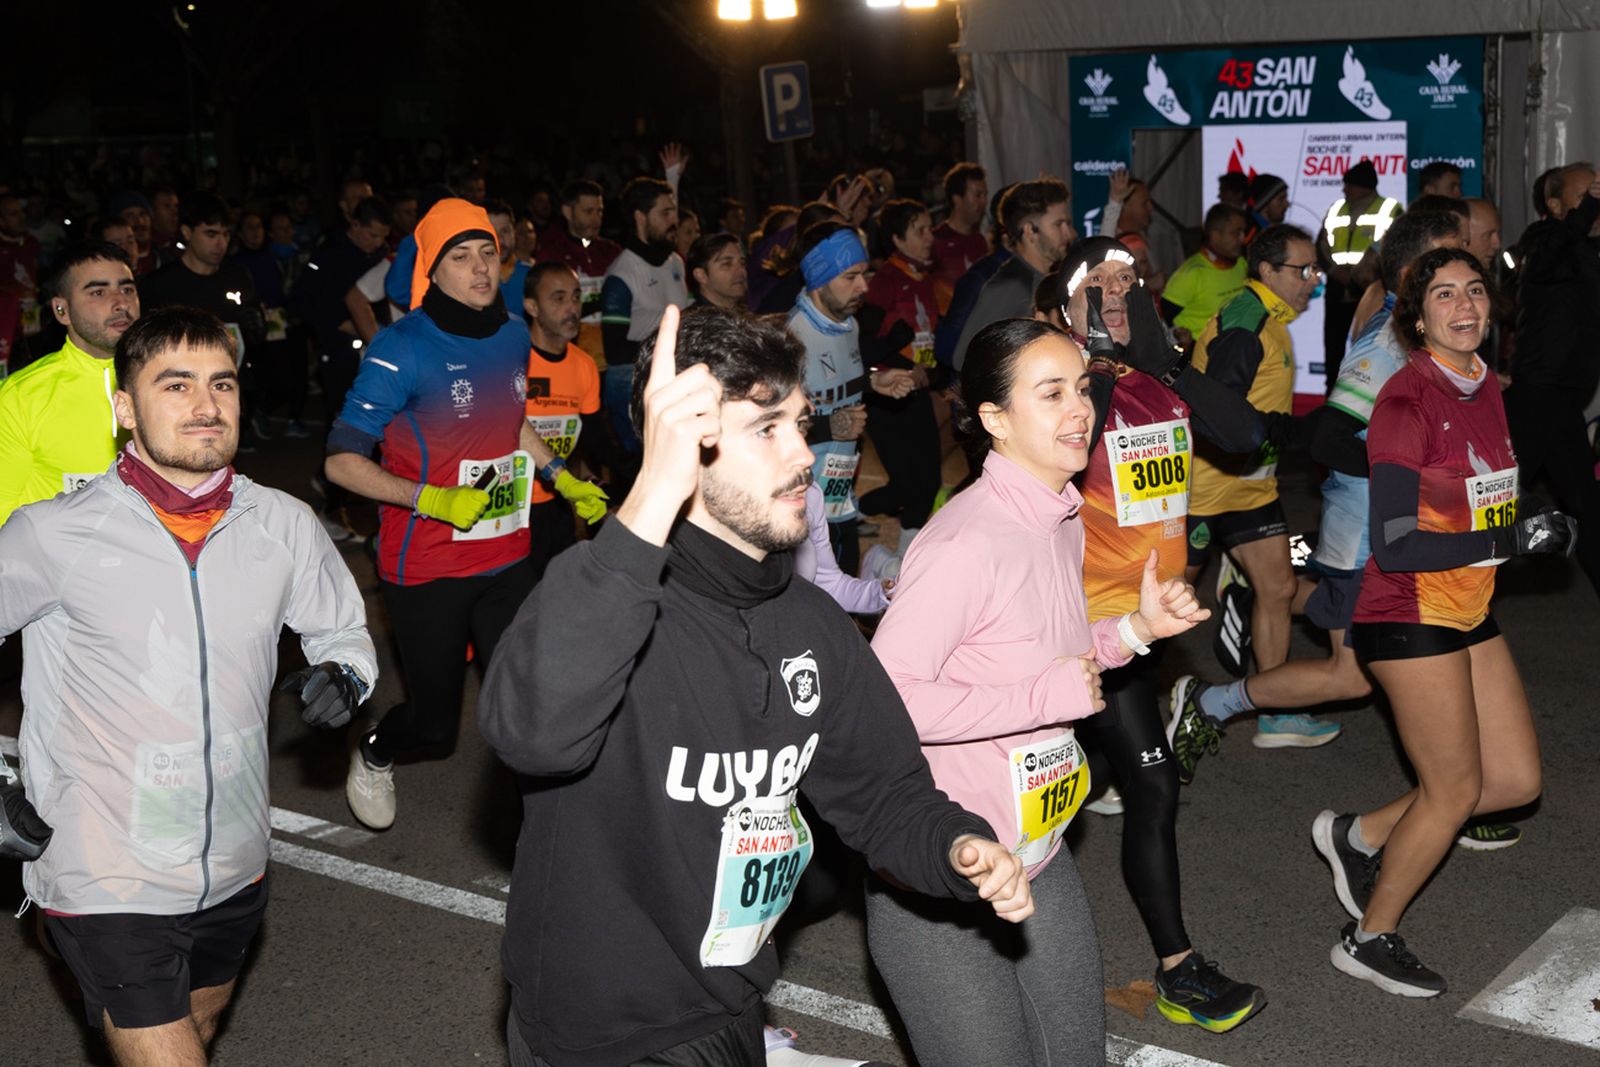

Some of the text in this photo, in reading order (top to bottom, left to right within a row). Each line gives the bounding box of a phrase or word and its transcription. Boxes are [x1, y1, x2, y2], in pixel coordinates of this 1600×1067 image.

[773, 73, 801, 132] P
[1157, 94, 1175, 113] 43
[1209, 81, 1311, 119] ANTÓN
[1354, 88, 1374, 109] 43
[1303, 155, 1351, 177] SAN
[1130, 435, 1156, 448] NOCHE
[1157, 433, 1167, 443] DE
[1121, 449, 1140, 462] SAN
[1131, 454, 1185, 491] 3008
[1485, 480, 1505, 493] NOCHE
[1477, 496, 1491, 508] SAN
[1038, 749, 1064, 770] NOCHE
[1065, 744, 1073, 759] DE
[665, 733, 820, 807] LUYBA
[1027, 771, 1047, 791] SAN
[1041, 770, 1080, 824] 1157
[736, 837, 760, 855] SAN
[740, 850, 801, 908] 8139
